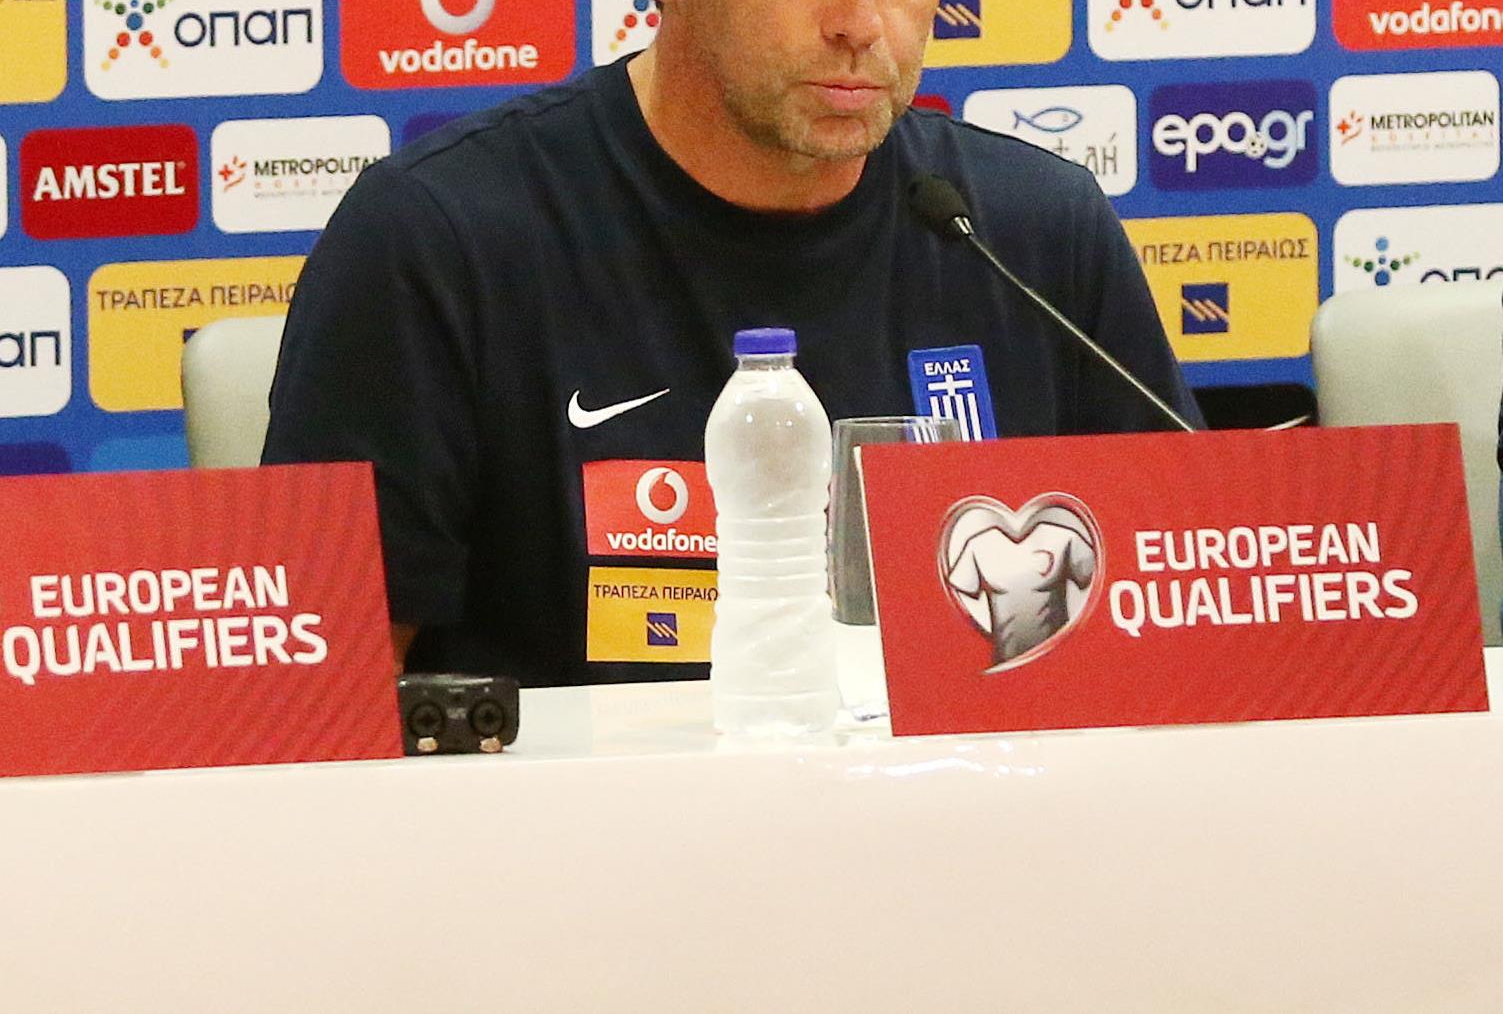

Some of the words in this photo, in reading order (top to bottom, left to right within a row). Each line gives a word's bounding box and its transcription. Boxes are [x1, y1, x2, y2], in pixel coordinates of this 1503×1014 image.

[1368, 0, 1503, 35] vodafon
[378, 40, 538, 74] vodafone
[1371, 111, 1494, 130] METROPOLITAN
[254, 156, 386, 176] METROPOLITA
[1142, 244, 1201, 264] ΠΕΖΑ
[1208, 239, 1310, 261] ΠΕΙΡΑΙΩΣ
[97, 288, 202, 311] ΤΡΑΠΕΖΑ
[211, 283, 297, 306] ΠΕΙΡΑΙ
[924, 359, 971, 375] ΕΛΛΑΣ
[606, 528, 717, 553] vodafone
[1135, 522, 1380, 572] EUROPEAN
[30, 565, 289, 618] EUROPEAN
[594, 584, 658, 599] ΤΡΑΠΕΖΑ
[663, 587, 718, 601] ΠΕΙΡΑΙΩ
[1109, 569, 1419, 637] QUALIFIERS
[1, 613, 328, 685] QUALIFIERS
